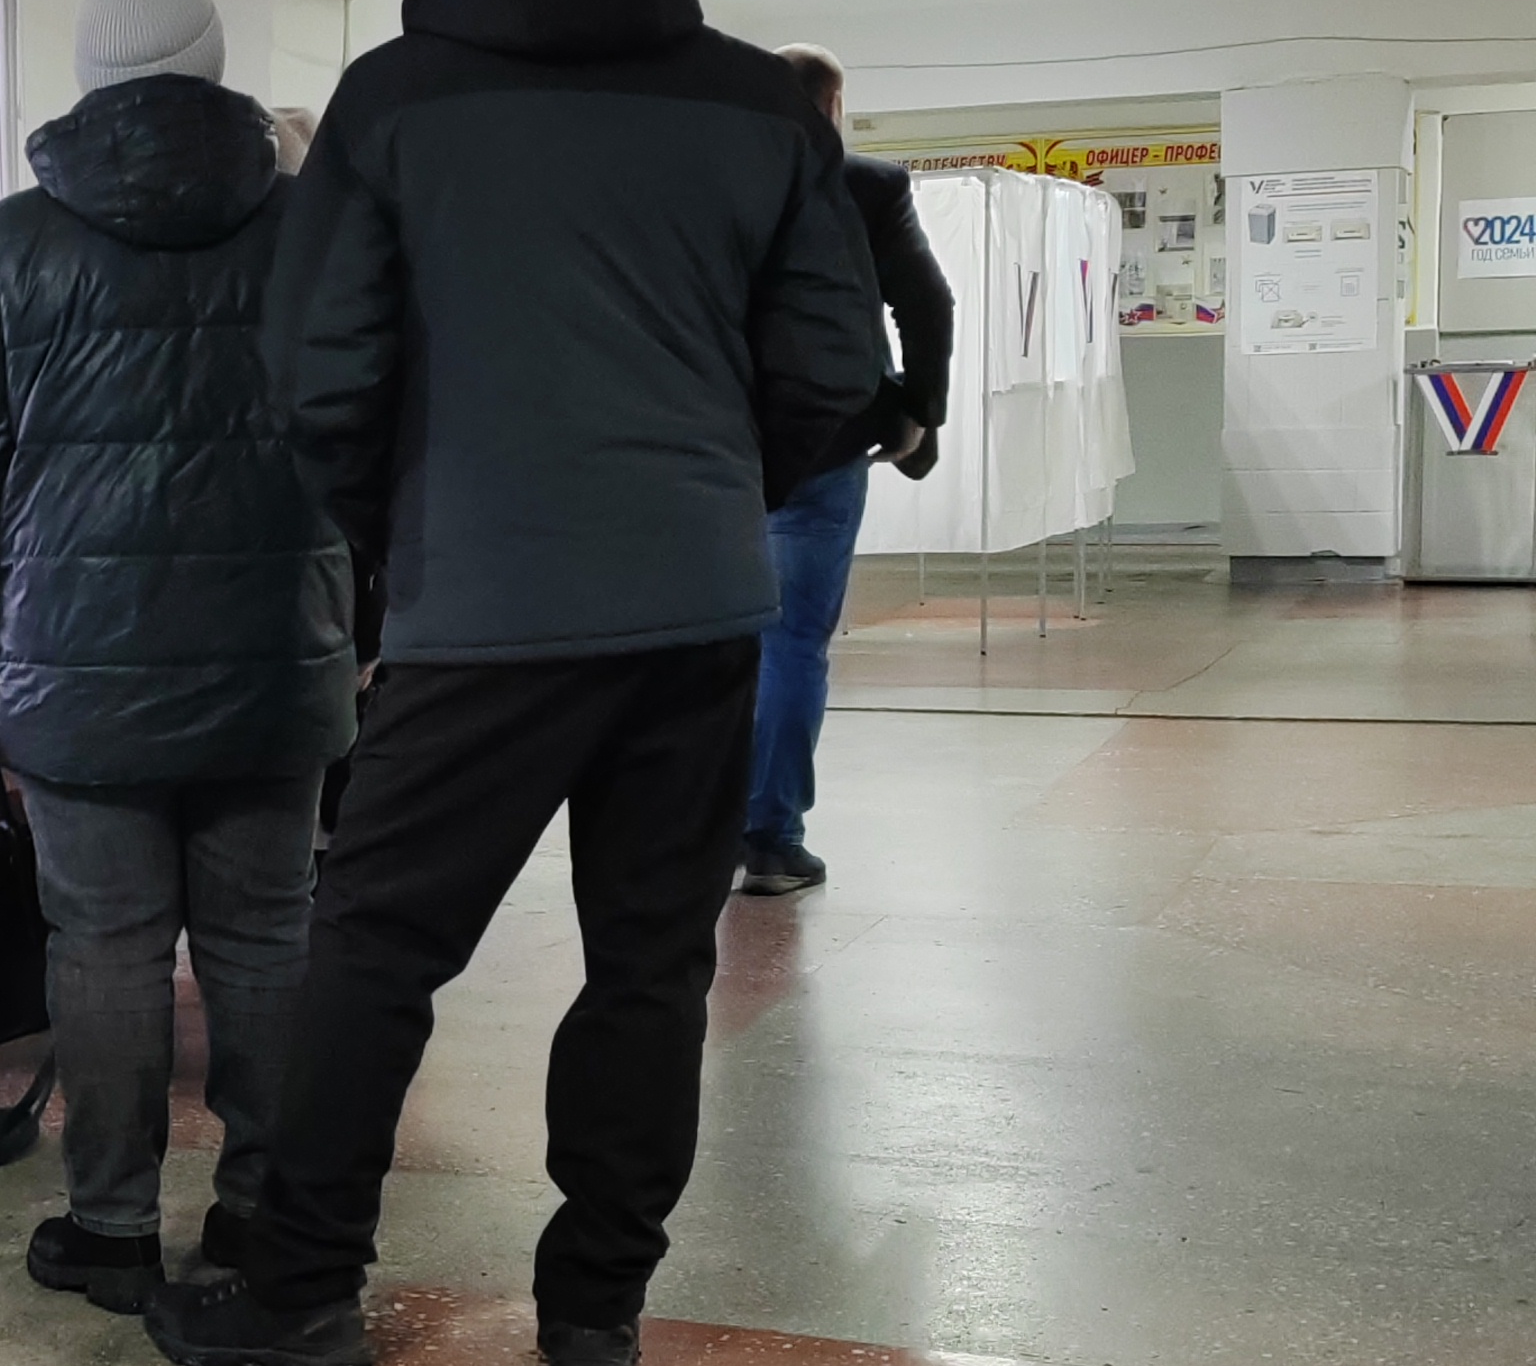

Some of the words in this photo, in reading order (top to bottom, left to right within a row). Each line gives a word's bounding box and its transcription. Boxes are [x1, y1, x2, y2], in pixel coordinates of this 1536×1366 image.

[1086, 147, 1149, 166] ОФИЦЕР
[1164, 143, 1221, 162] ПРОФЕ
[1474, 215, 1536, 245] 2024
